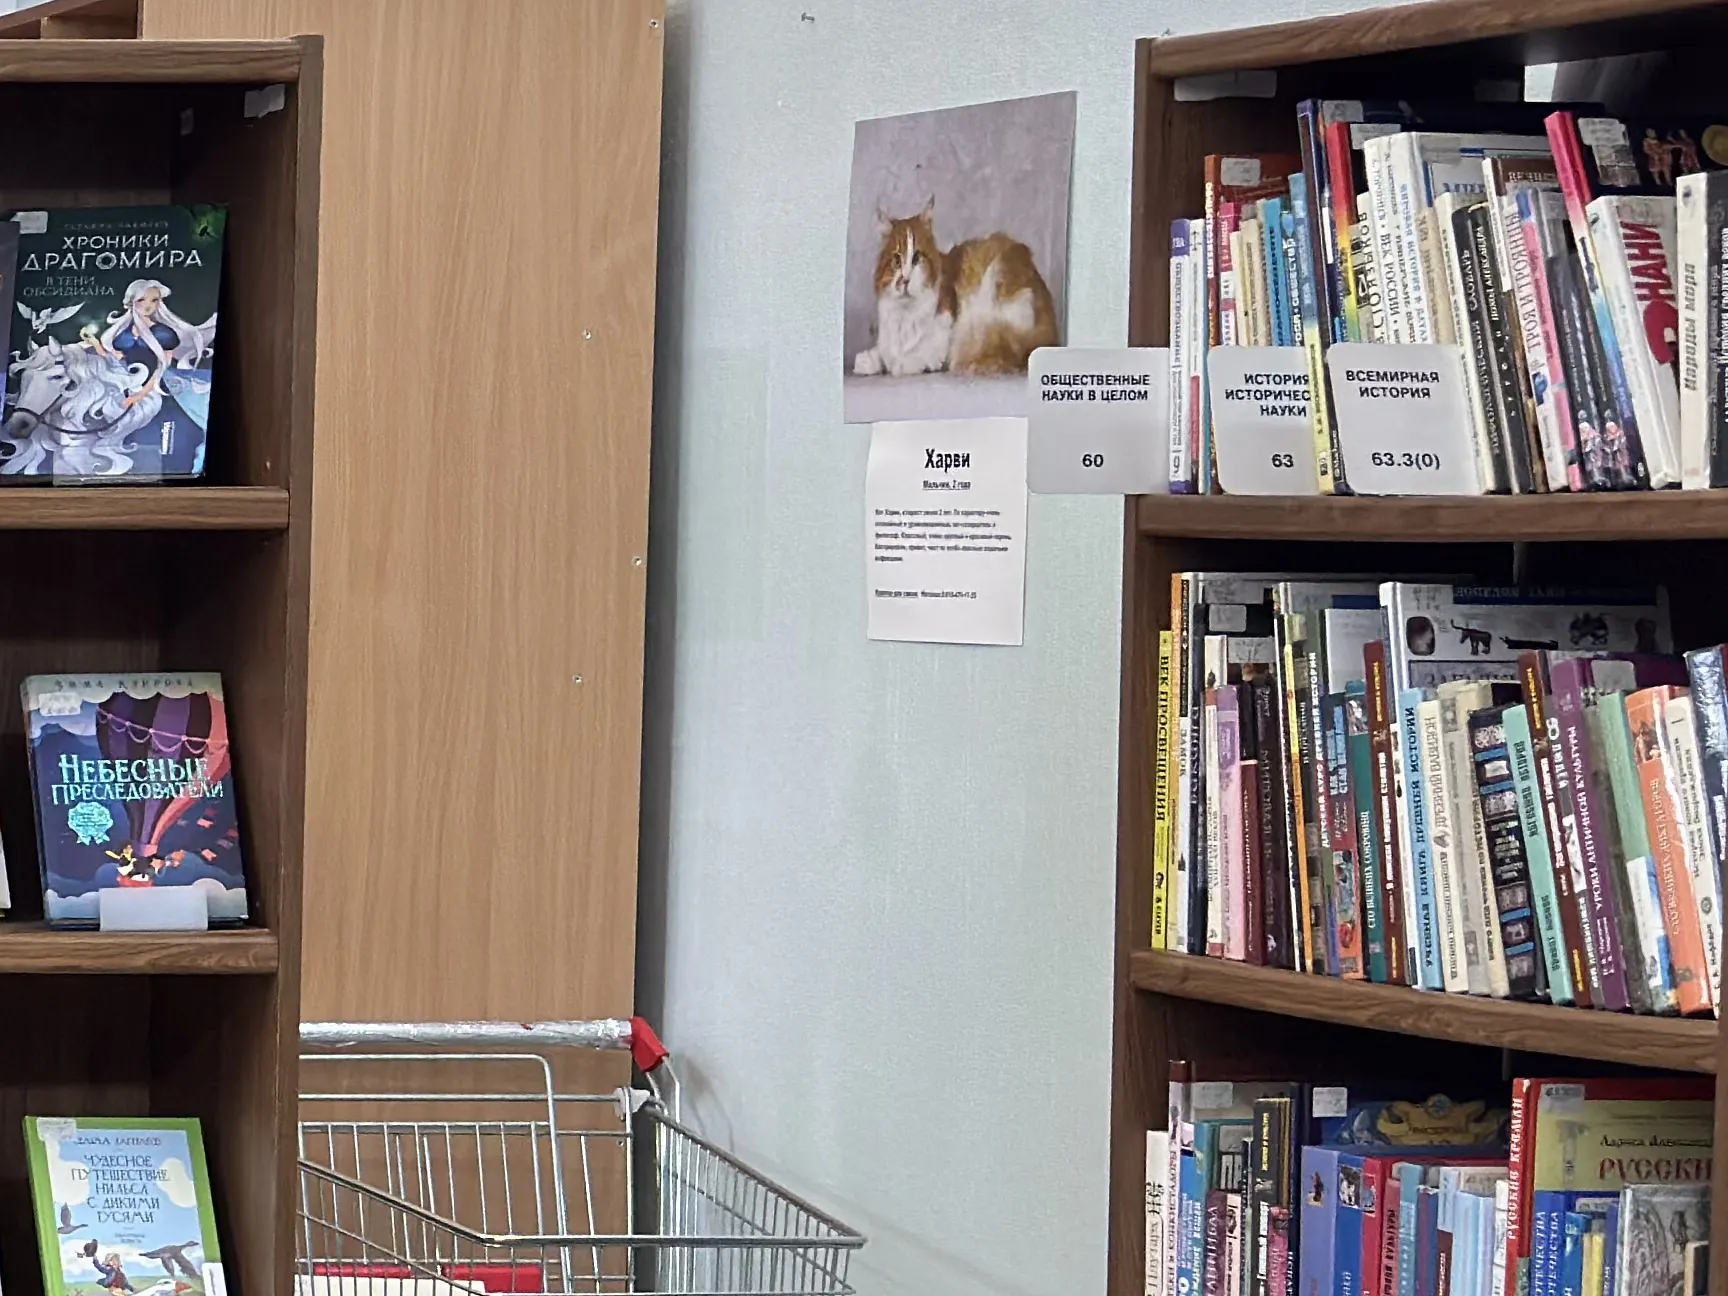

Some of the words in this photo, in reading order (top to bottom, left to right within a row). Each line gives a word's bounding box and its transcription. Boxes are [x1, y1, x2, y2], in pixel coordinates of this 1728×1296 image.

[62, 233, 170, 250] ХРОНИКИ
[21, 249, 204, 272] ДРАГОМИРА
[1040, 373, 1151, 388] ОБЩЕСТВЕННЫЕ
[1243, 373, 1311, 388] ИСТОРИЯ
[1346, 369, 1441, 385] ВСЕМИРНАЯ
[1041, 389, 1083, 403] НАУКИ
[1087, 389, 1097, 402] В
[1101, 389, 1149, 404] ЦЕЛОМ
[1359, 385, 1431, 401] ИСТОРИЯ
[1260, 404, 1307, 419] НАУКИ
[924, 448, 972, 474] Харви
[1081, 452, 1105, 469] 60
[1271, 452, 1296, 469] 63
[1371, 451, 1442, 474] 63.3(0)
[1154, 690, 1169, 823] ПРОСВЕЩЕНИЯ
[58, 753, 212, 785] НЕБЕСНЫЕ
[51, 781, 225, 806] ПРЕСЛЕДОВАТЕЛИ
[83, 1154, 153, 1169] ЧУДЕСНОЕ
[70, 1167, 171, 1183] ПУТЕШЕСТВИЕ
[94, 1181, 149, 1197] НИЛЬСА
[100, 1196, 161, 1211] ДИКИМИ
[97, 1210, 156, 1225] ГУСЯМИ
